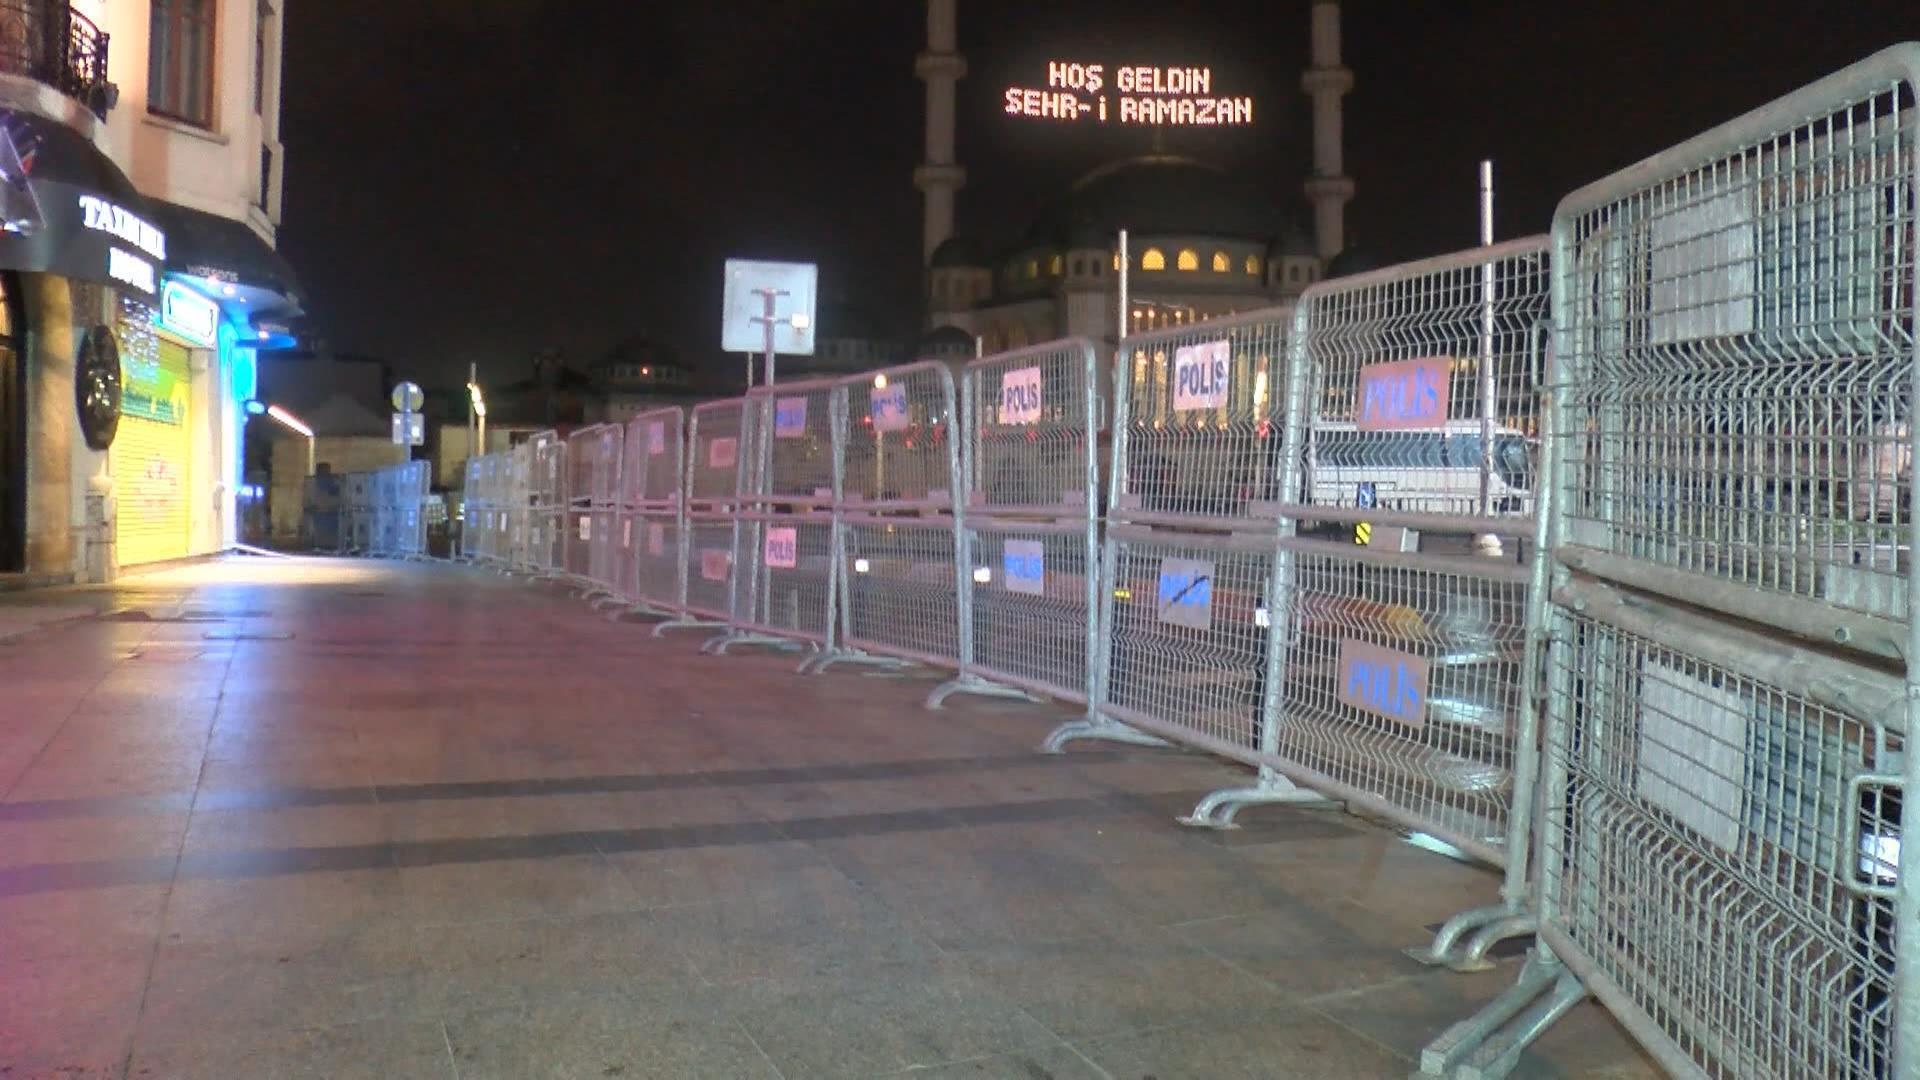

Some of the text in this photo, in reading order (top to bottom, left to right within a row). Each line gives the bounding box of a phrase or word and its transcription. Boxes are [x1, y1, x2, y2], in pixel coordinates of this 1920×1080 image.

[1049, 61, 1103, 93] HOŞ
[1120, 97, 1252, 124] RAMAZAN
[1179, 352, 1227, 397] POLİS
